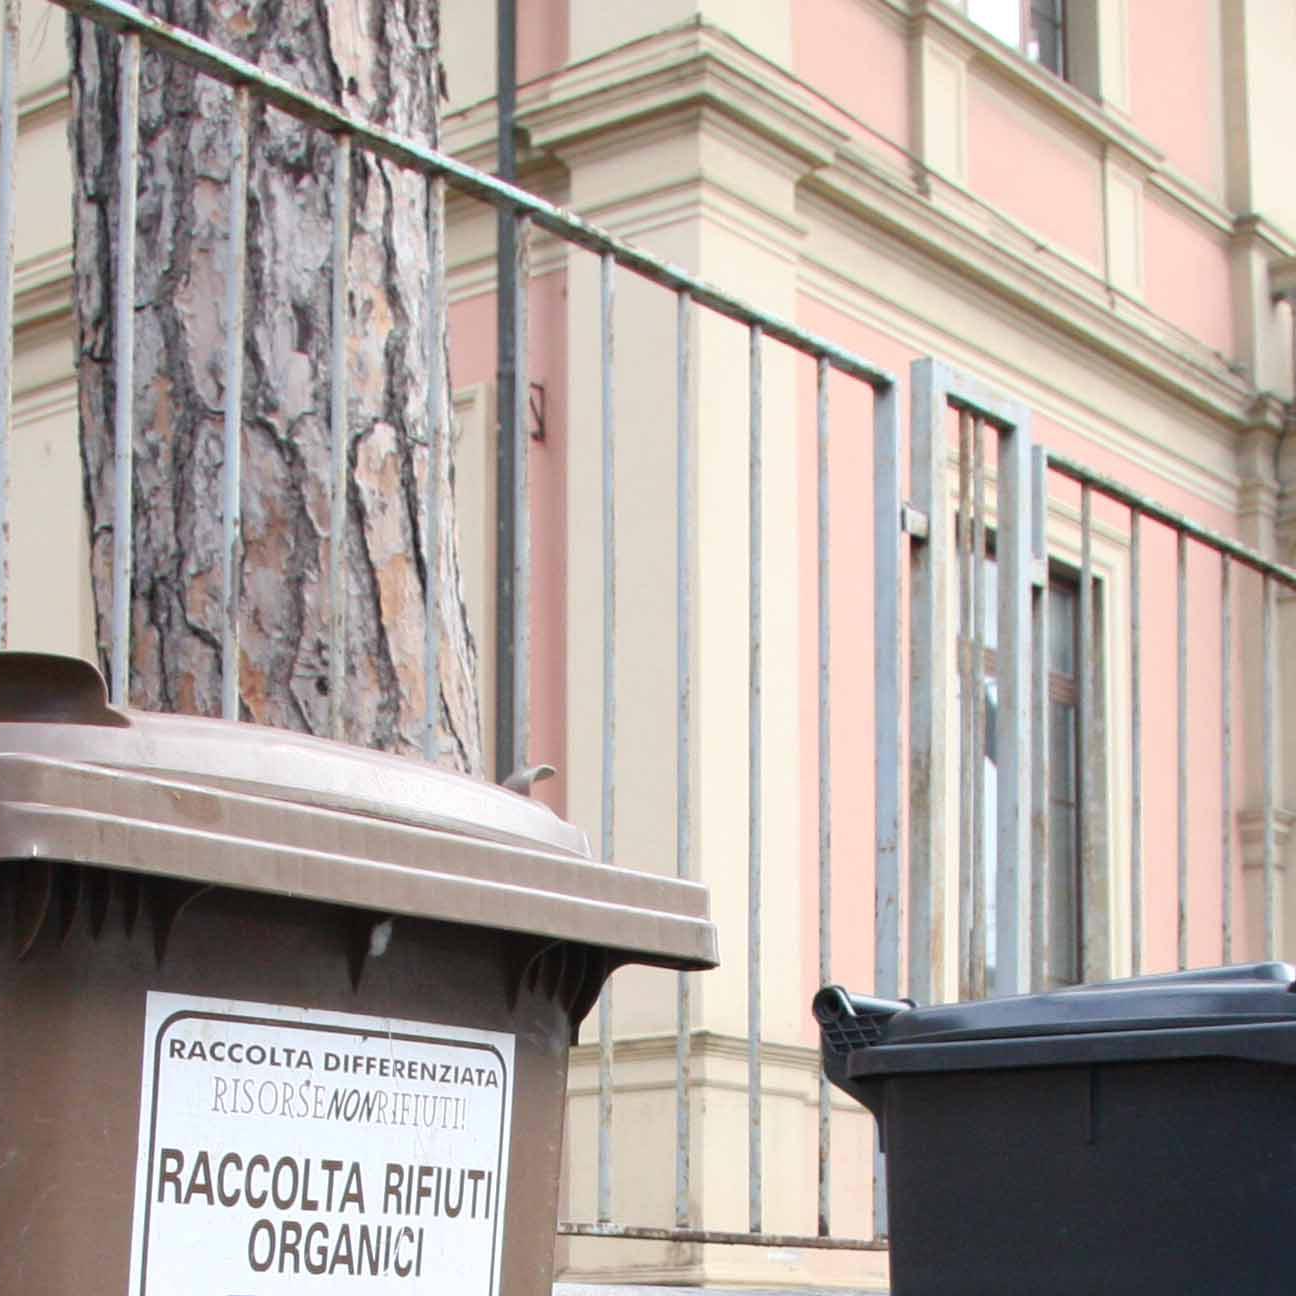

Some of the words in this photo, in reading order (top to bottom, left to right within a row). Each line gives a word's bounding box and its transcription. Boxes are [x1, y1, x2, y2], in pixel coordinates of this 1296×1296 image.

[169, 1038, 314, 1071] RACCOLTA
[323, 1052, 499, 1089] DIFFERENZIATA
[157, 1147, 366, 1214] RACCOLTA
[382, 1162, 493, 1219] RIFIUTI
[247, 1218, 424, 1278] ORGANICI
